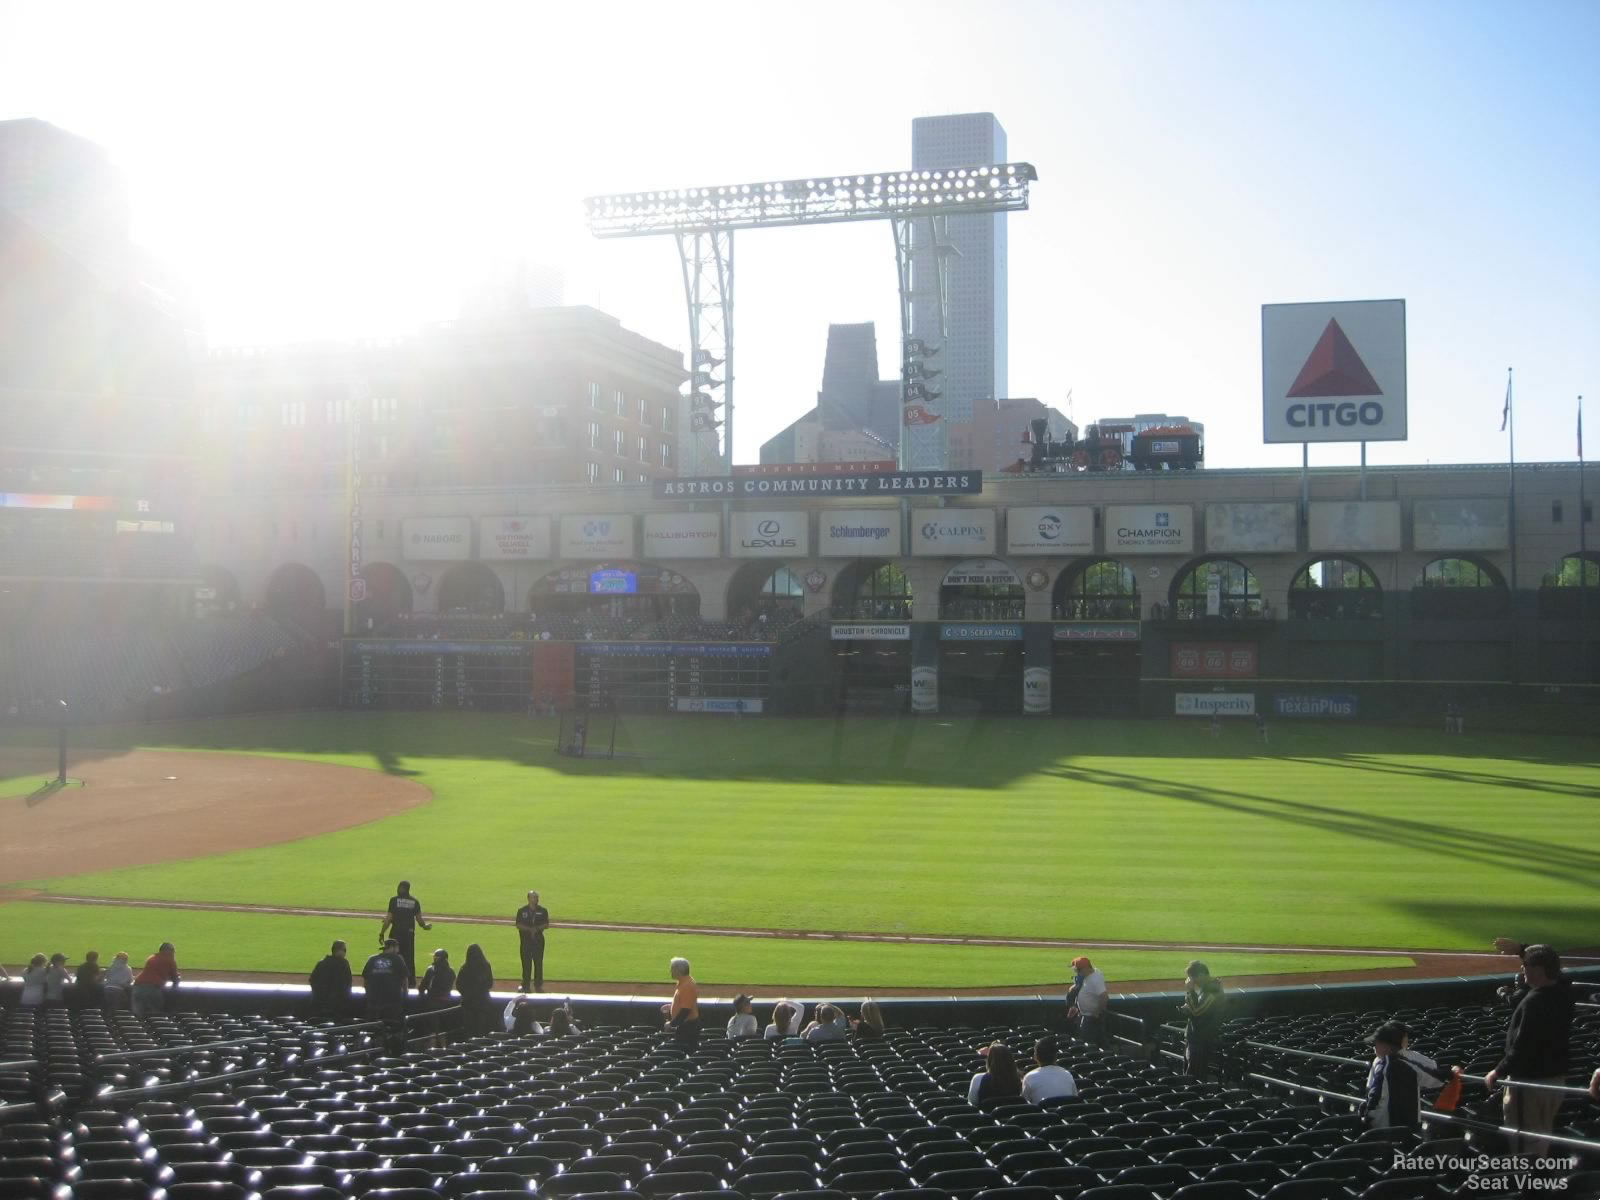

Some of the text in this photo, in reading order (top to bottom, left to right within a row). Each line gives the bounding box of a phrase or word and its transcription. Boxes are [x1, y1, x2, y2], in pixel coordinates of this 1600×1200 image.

[908, 366, 918, 374] 01
[907, 387, 919, 396] 04
[907, 409, 919, 419] 05
[1286, 402, 1384, 428] CITGO
[664, 475, 969, 495] ASTROS COMMUNITY LEADERS
[646, 531, 720, 539] HALLIBURTON
[830, 525, 890, 540] Schlumberger
[939, 527, 984, 536] CALPINE
[742, 539, 797, 548] LEXUS
[352, 521, 361, 577] FARE
[834, 627, 906, 635] HOUSTON CHRONICLE
[994, 629, 1017, 637] METAL
[1194, 697, 1253, 714] Insperity
[1279, 698, 1352, 715] TexanPlus
